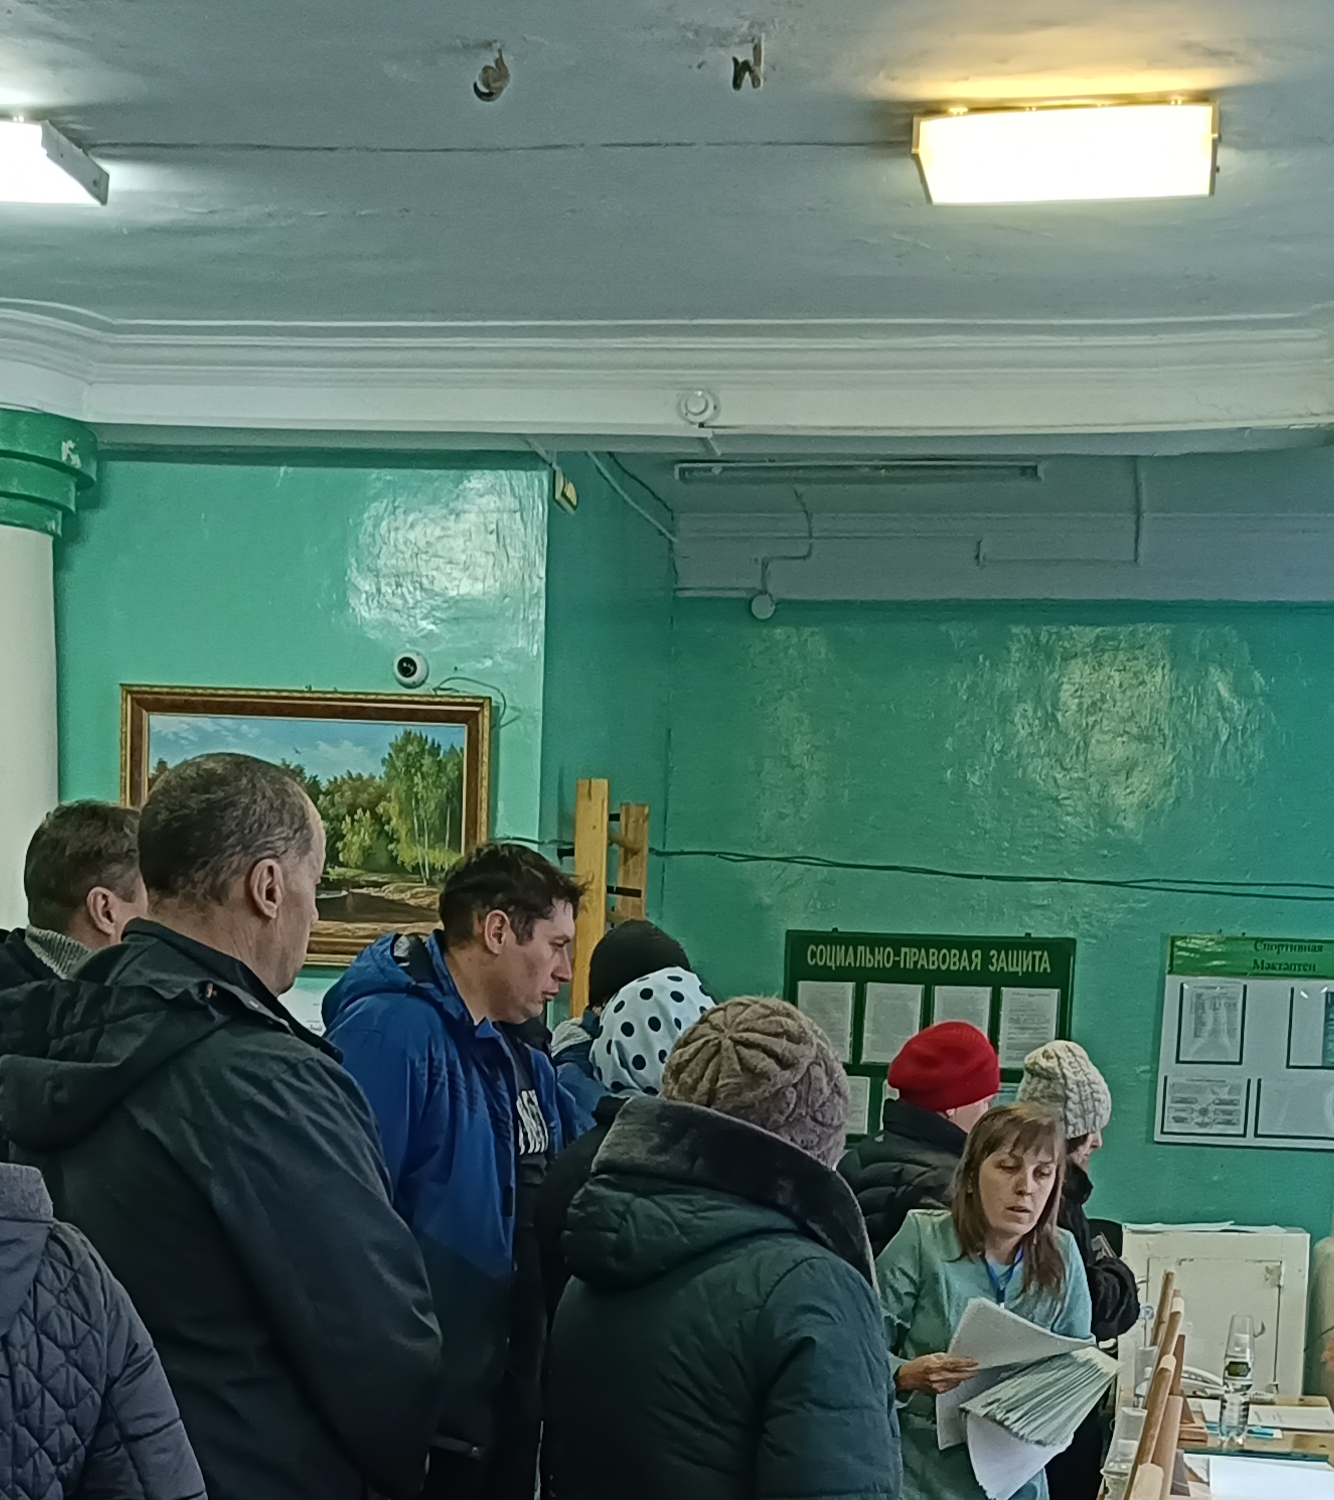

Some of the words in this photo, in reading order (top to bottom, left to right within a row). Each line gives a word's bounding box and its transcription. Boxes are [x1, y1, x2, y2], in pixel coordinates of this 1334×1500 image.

[1254, 940, 1324, 955] Спортивная
[807, 944, 982, 971] СОЦИАЛЬНО-ПРАВОВАЯ
[988, 950, 1051, 976] ЗАЩИТА
